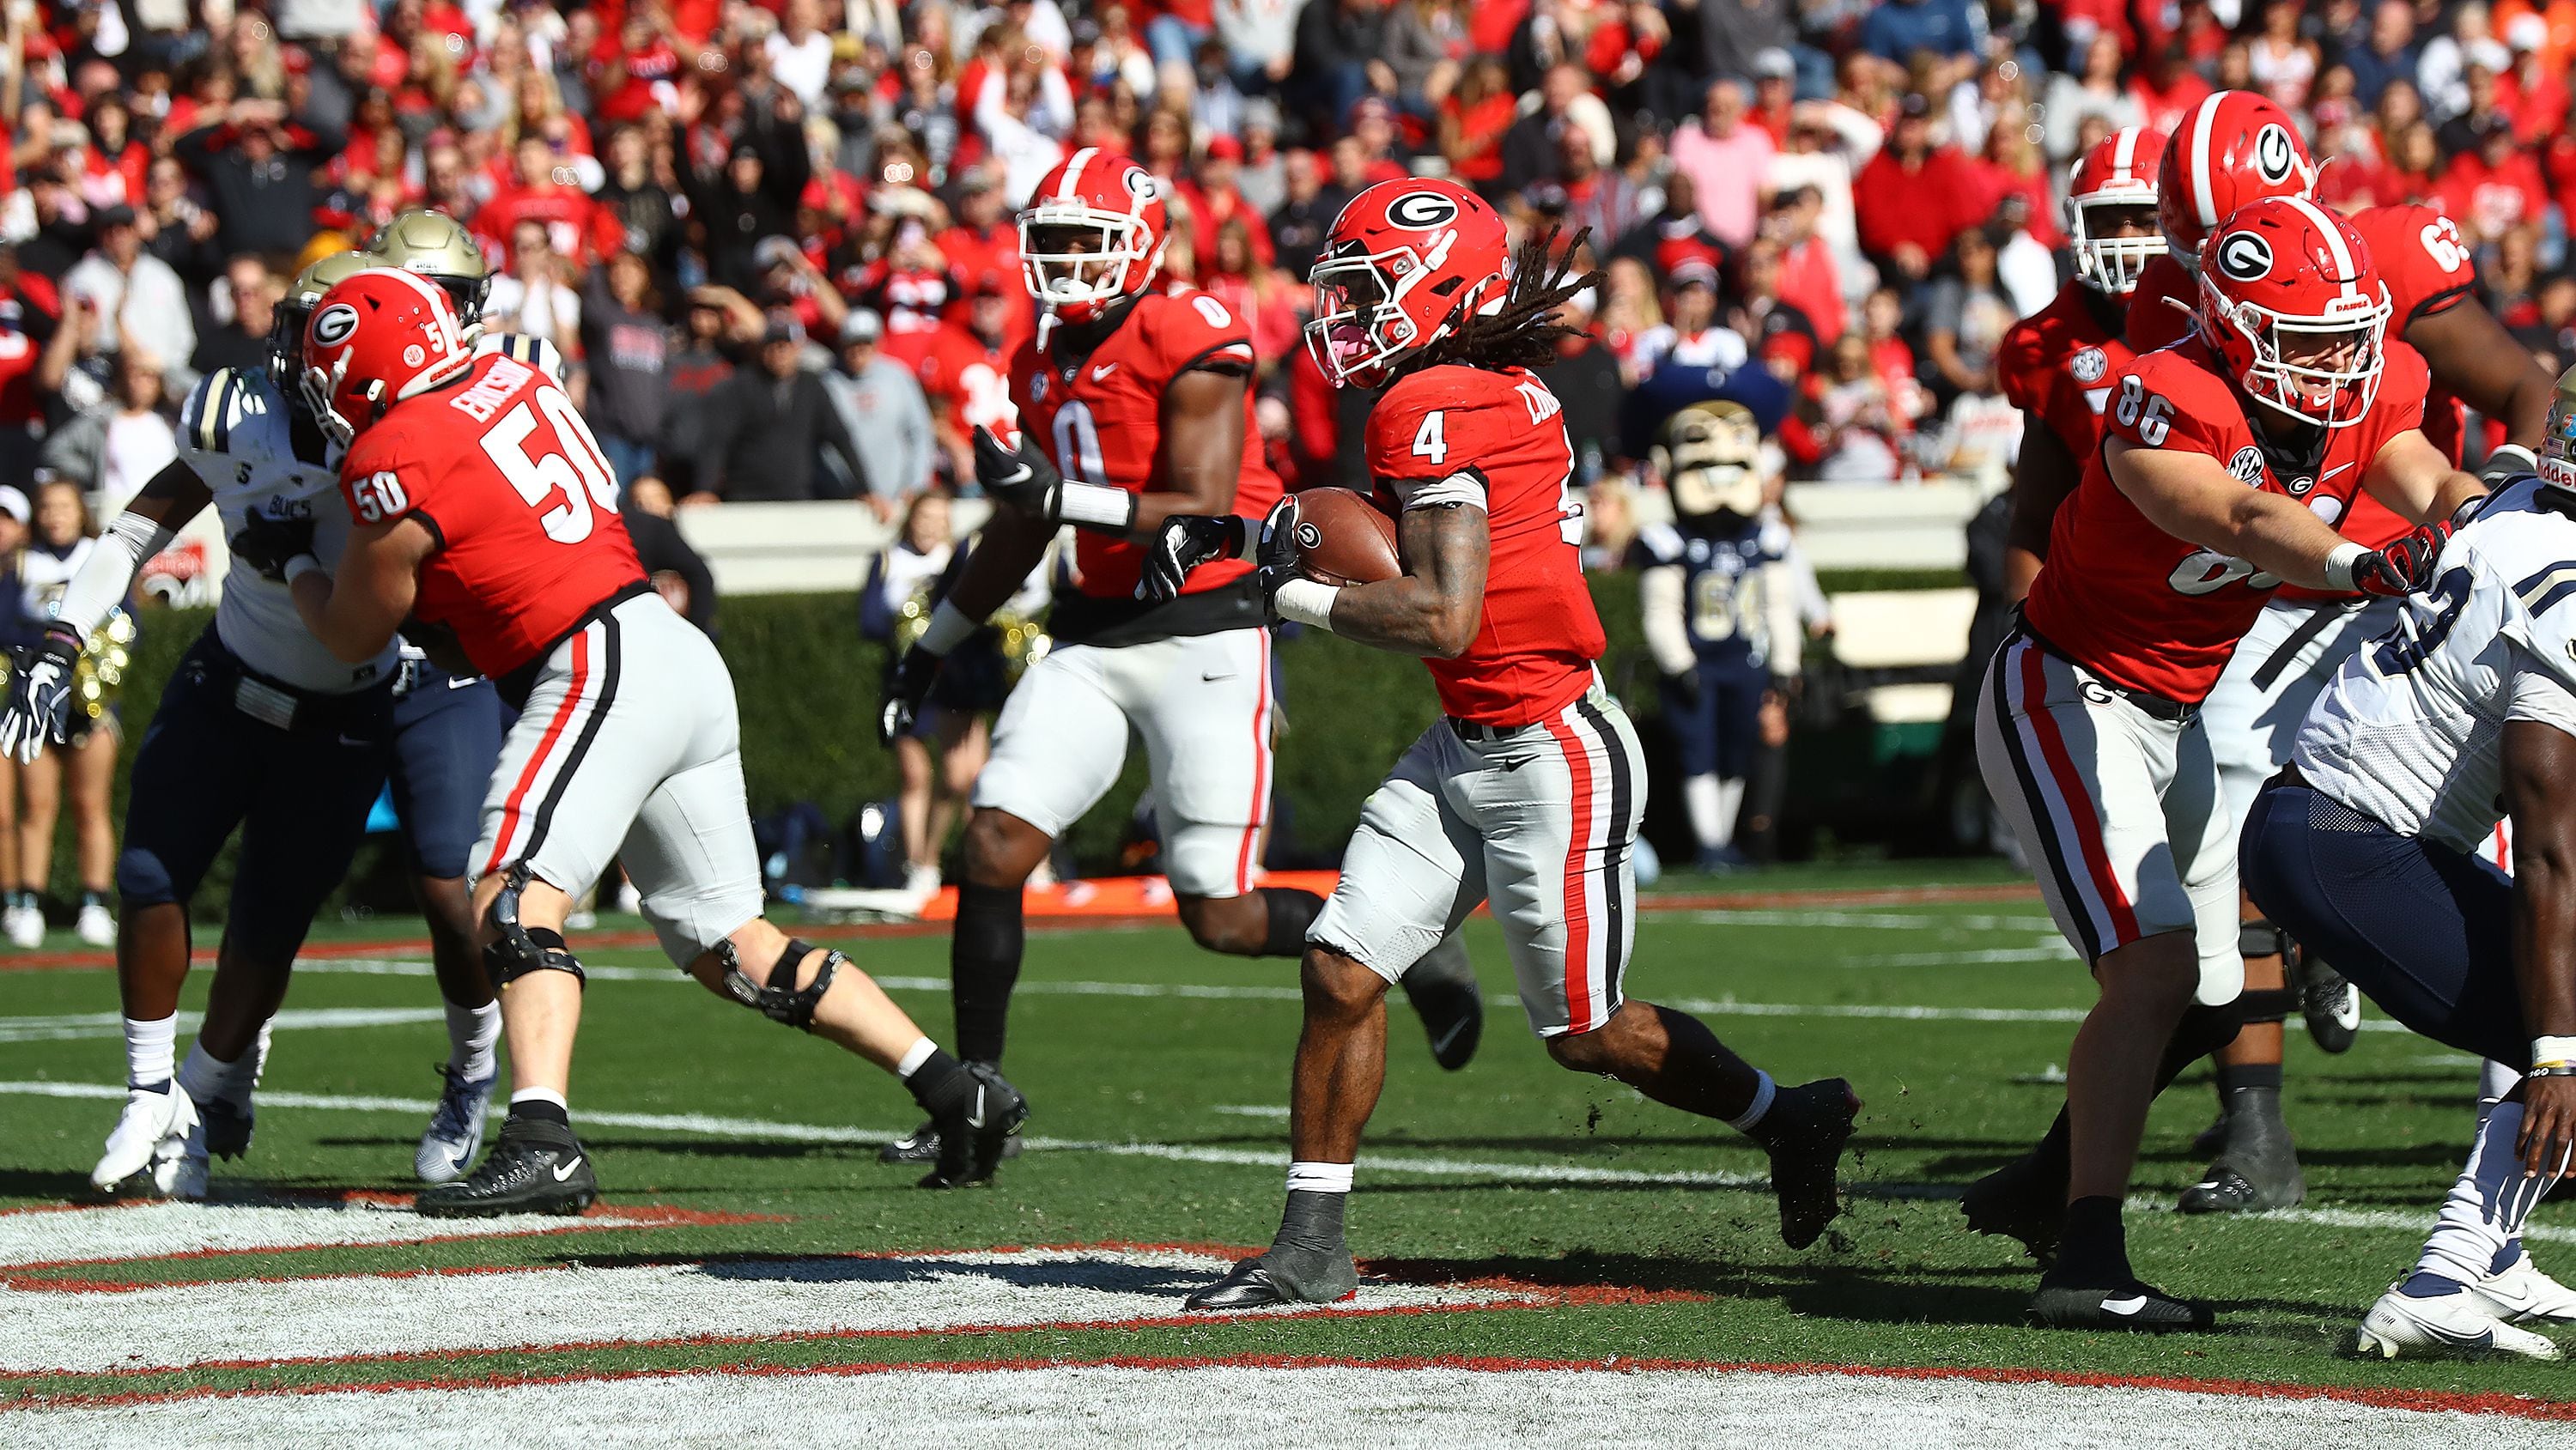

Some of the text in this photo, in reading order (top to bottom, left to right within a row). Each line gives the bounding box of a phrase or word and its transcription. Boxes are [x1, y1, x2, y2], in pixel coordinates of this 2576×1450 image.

[2260, 127, 2290, 180] G
[1389, 194, 1455, 228] G
[2218, 234, 2273, 280] G
[314, 307, 359, 340] G
[1192, 295, 1232, 330] 0
[2117, 375, 2175, 446] 86
[1412, 410, 1448, 464] 4
[478, 384, 621, 544] 50
[2290, 477, 2313, 494] G
[351, 471, 408, 523] 50
[2077, 681, 2113, 704] G
